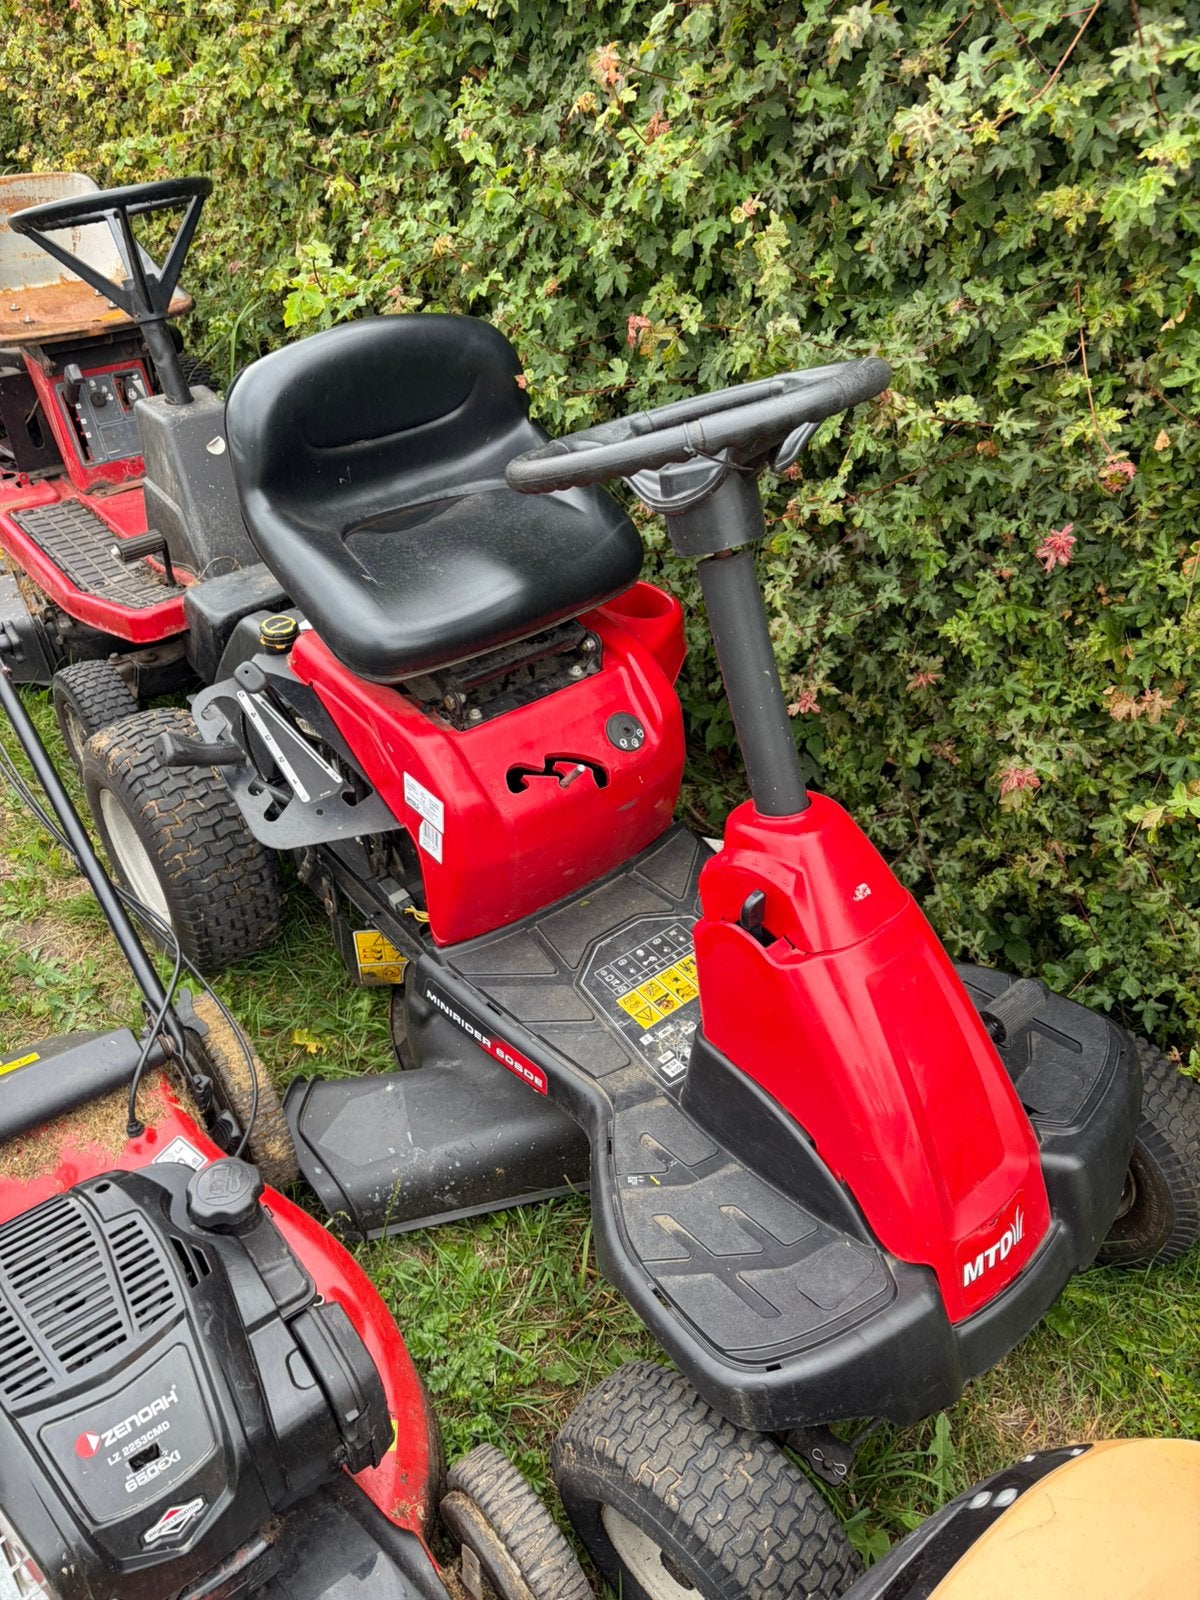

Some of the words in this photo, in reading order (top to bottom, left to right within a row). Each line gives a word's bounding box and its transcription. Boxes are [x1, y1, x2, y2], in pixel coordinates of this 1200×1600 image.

[426, 989, 492, 1049] MINIRIDER
[963, 1230, 1013, 1288] MTD
[100, 1388, 179, 1448] ZENOAH
[107, 1451, 122, 1467] LZ
[121, 1420, 171, 1457] 2253CMD
